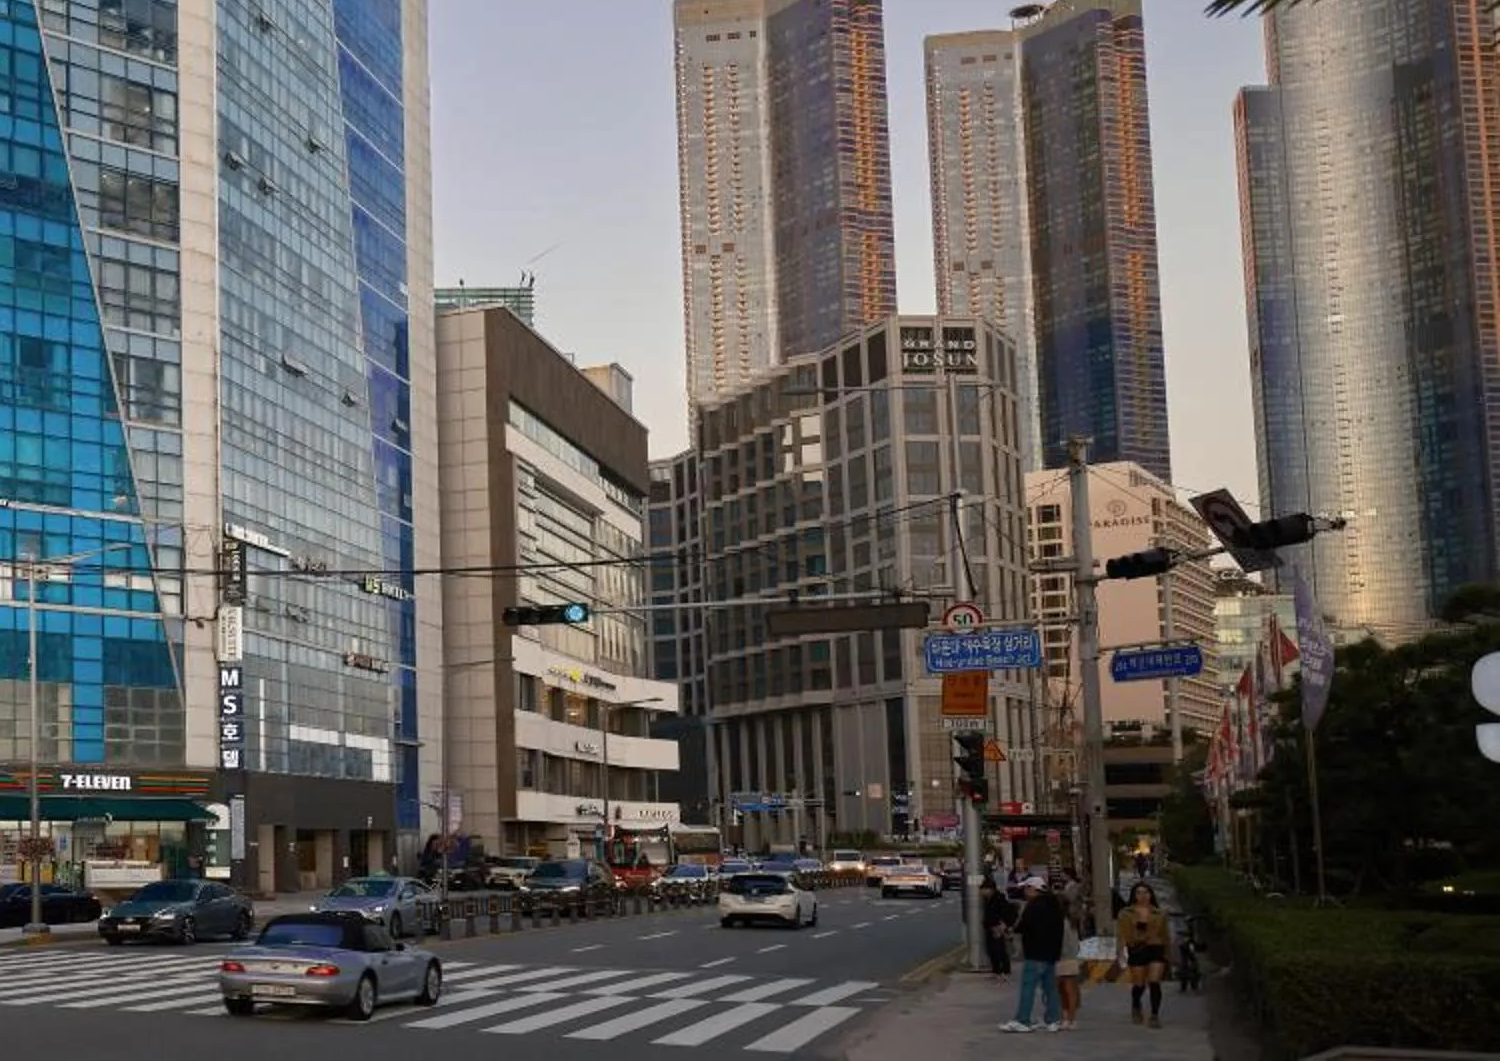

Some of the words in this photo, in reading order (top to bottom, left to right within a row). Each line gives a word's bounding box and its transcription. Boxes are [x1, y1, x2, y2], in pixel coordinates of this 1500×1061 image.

[903, 339, 975, 350] GRAND
[903, 352, 978, 368] JOSUN
[1089, 515, 1149, 528] ARADISE
[953, 613, 973, 626] 50
